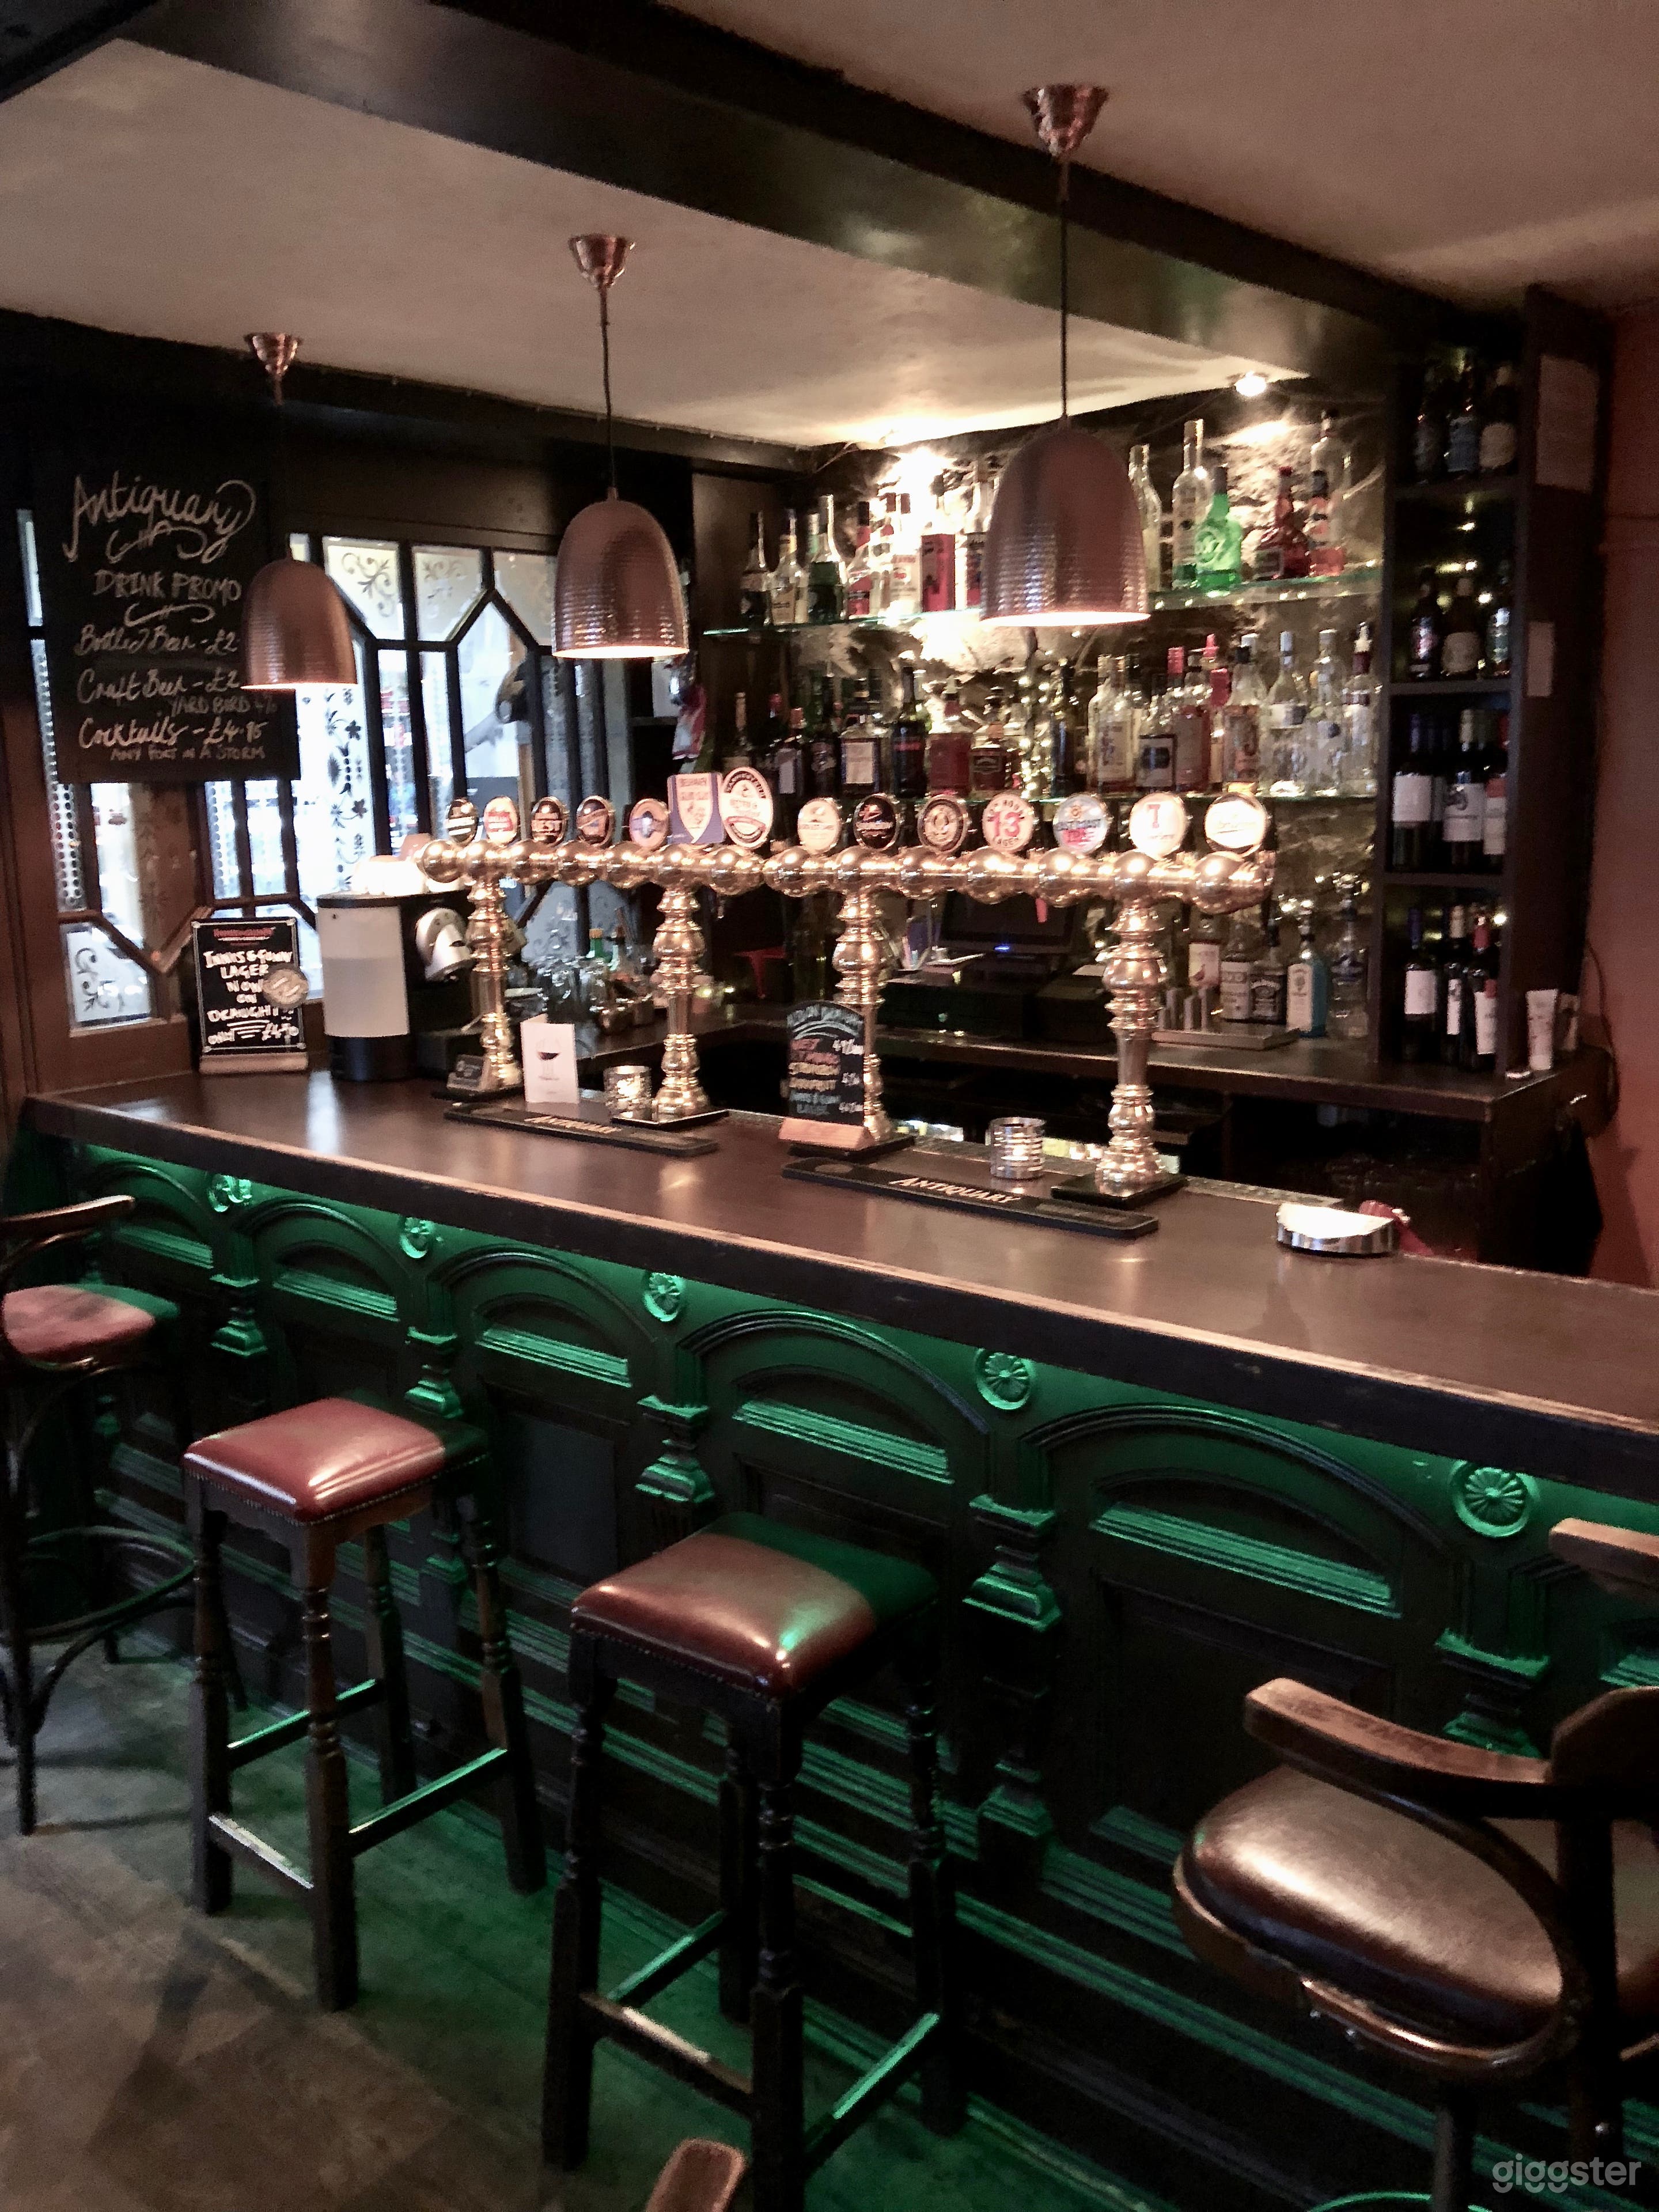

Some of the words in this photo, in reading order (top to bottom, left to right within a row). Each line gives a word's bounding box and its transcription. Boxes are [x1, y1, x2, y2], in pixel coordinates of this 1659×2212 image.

[62, 470, 256, 563] Antiquary
[93, 569, 164, 599] DRINK
[172, 571, 243, 607] PROMO
[78, 713, 189, 749] Cocktails
[987, 811, 1020, 837] 13
[220, 964, 269, 979] LAGER
[888, 1177, 1022, 1203] ANTIQUARY
